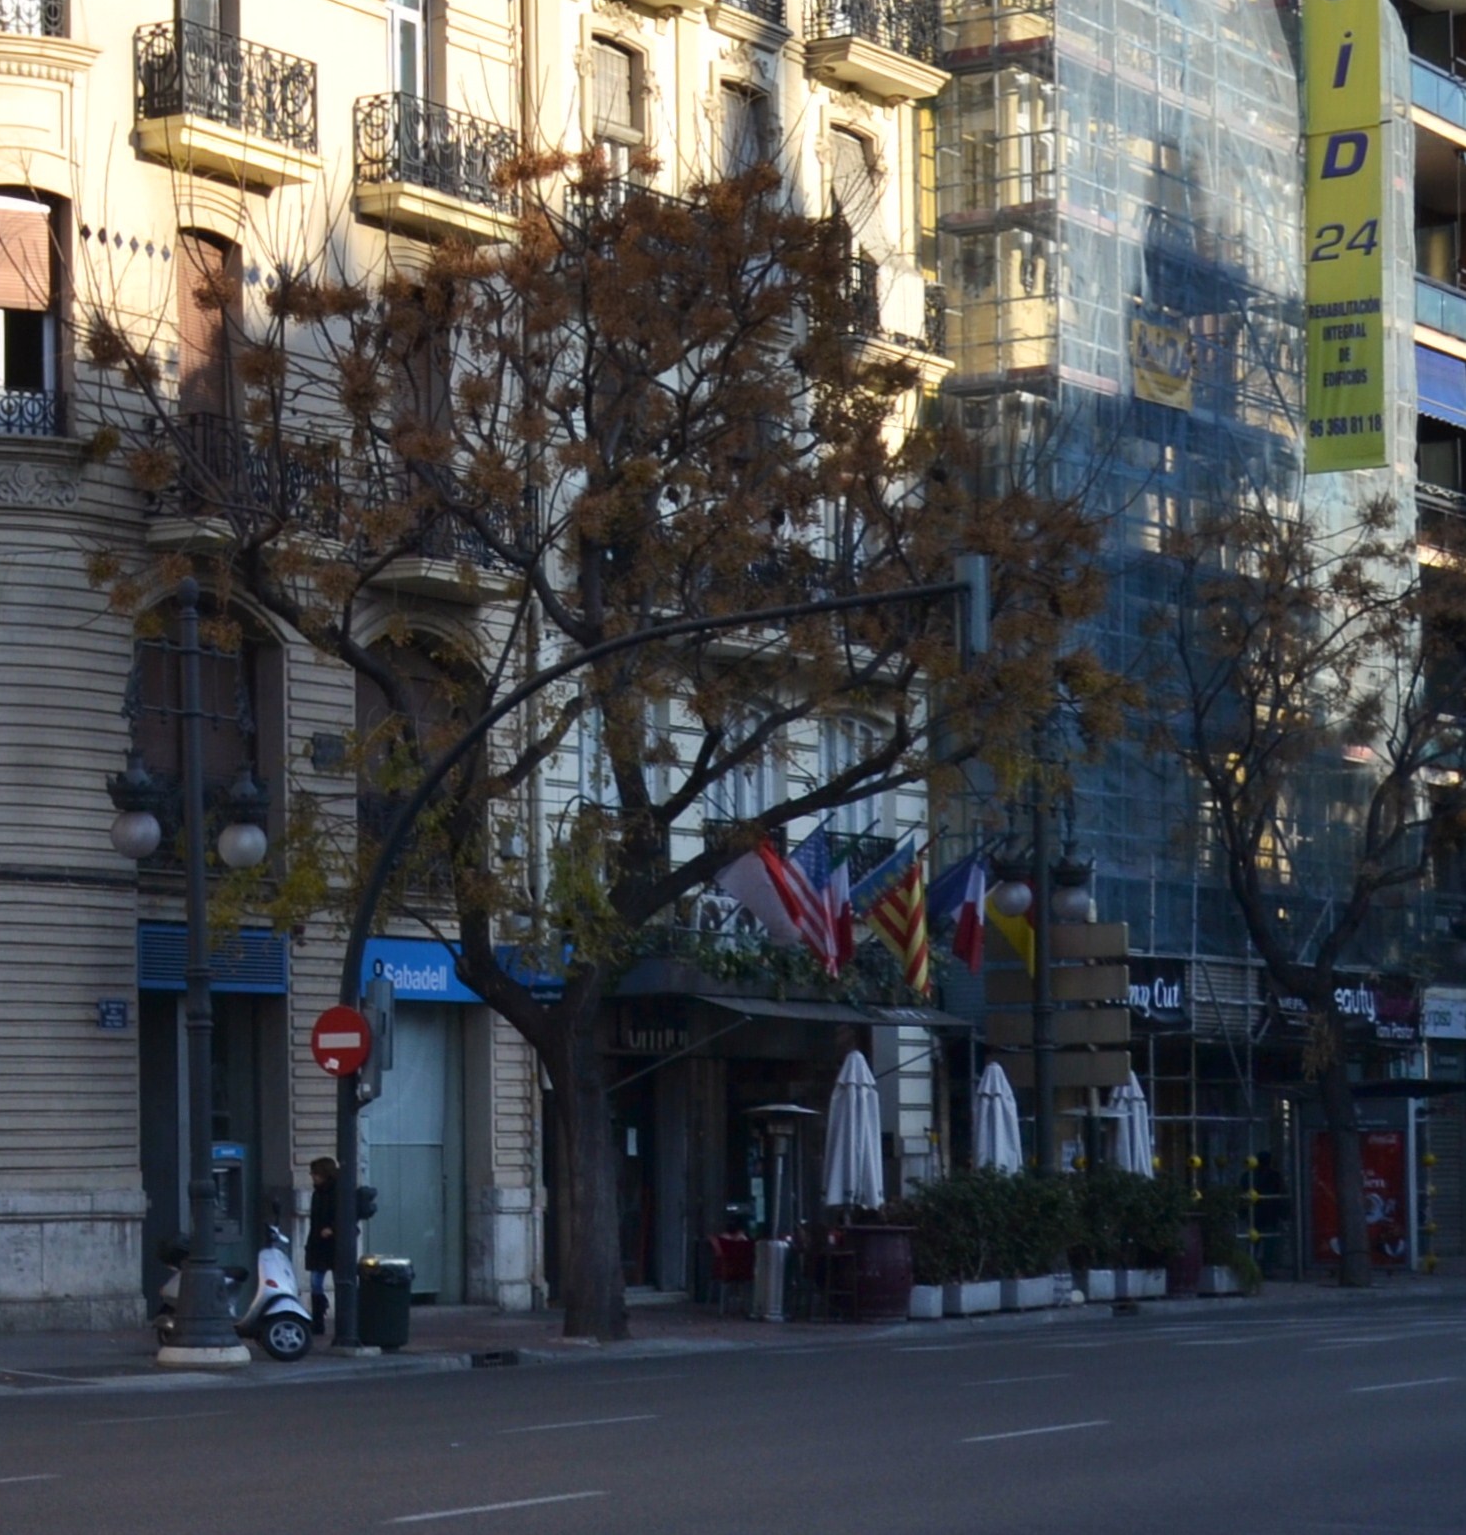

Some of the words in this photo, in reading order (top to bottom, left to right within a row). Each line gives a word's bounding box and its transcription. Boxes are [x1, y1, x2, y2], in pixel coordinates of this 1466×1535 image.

[1311, 219, 1378, 262] 24
[1309, 297, 1381, 320] REHABILITACIÓN
[1323, 322, 1366, 341] INTEGRAL
[1339, 347, 1351, 362] DE
[1323, 368, 1367, 387] EDIFICIOS
[1154, 976, 1181, 1008] Cut
[1334, 982, 1377, 1022] eauty
